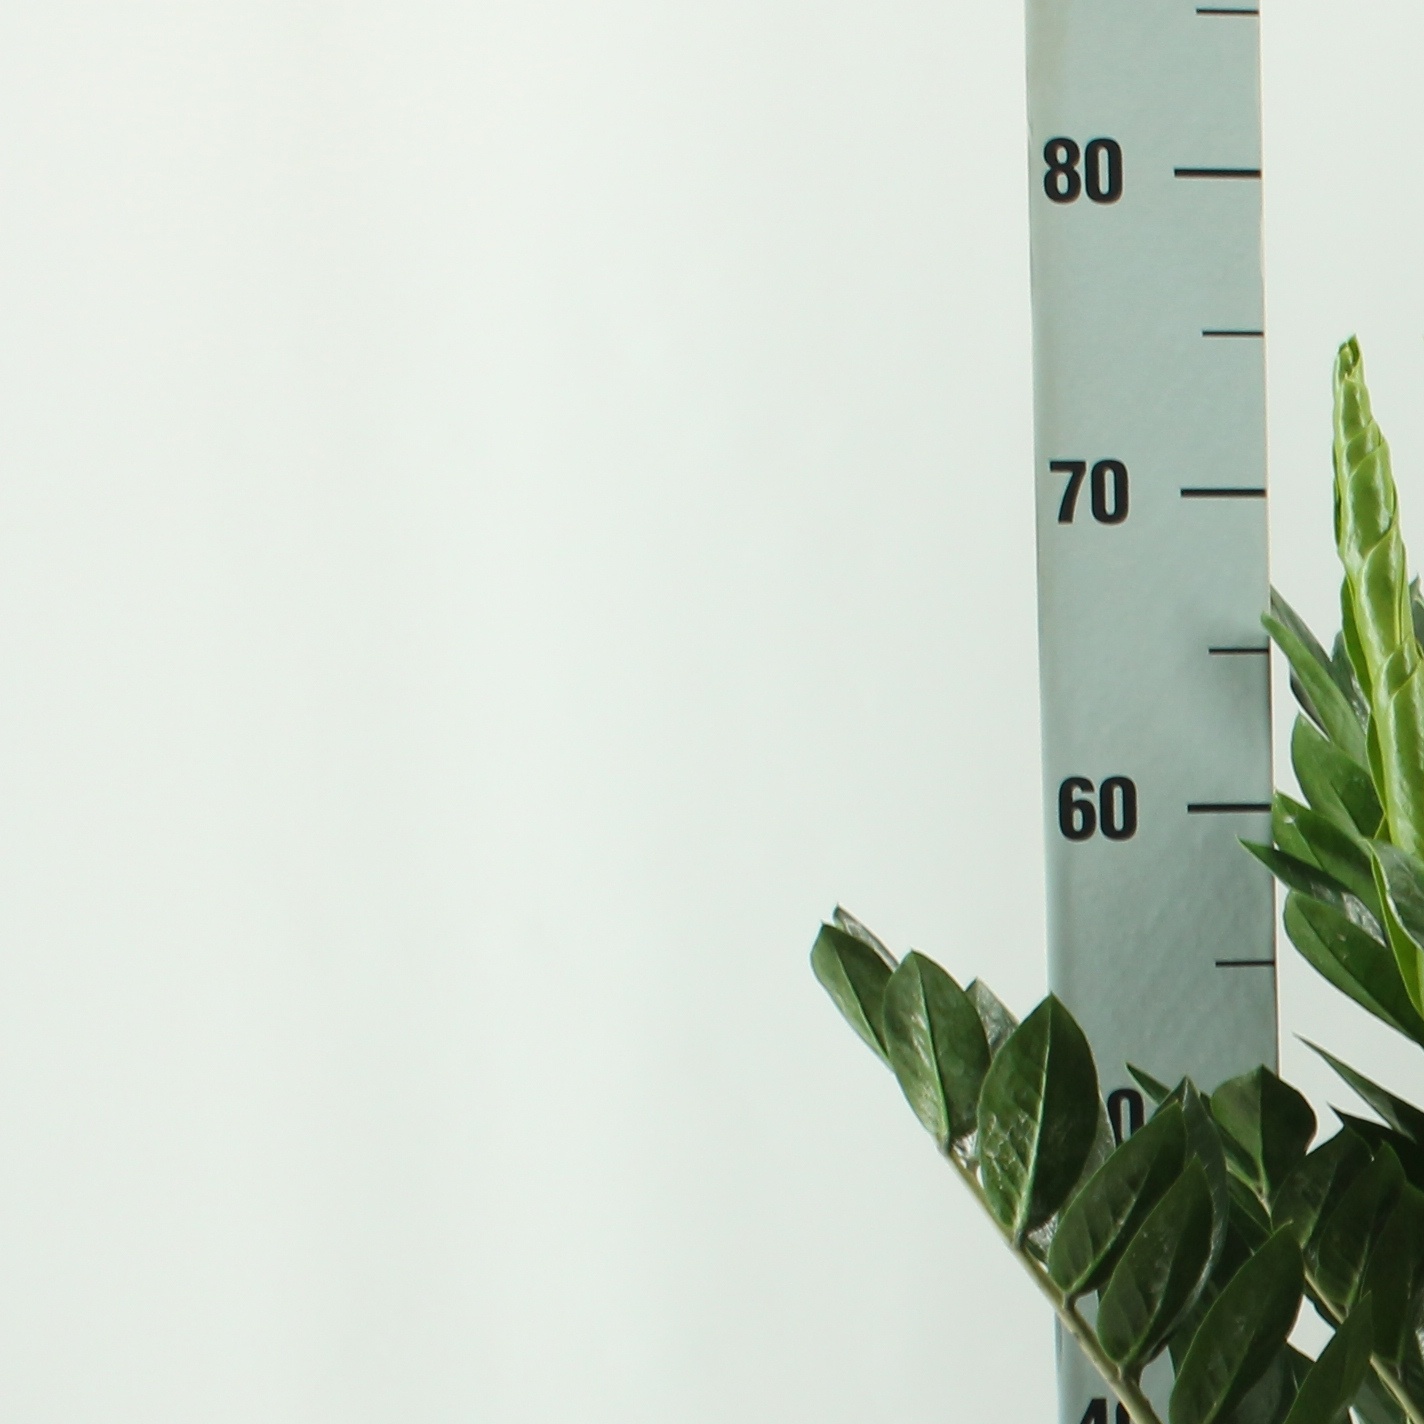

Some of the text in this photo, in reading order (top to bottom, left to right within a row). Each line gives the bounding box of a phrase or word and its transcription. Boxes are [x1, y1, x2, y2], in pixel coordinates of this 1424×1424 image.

[1043, 137, 1123, 204] 80
[1049, 459, 1129, 525] 70
[1058, 775, 1137, 842] 60
[1107, 1088, 1144, 1149] 0
